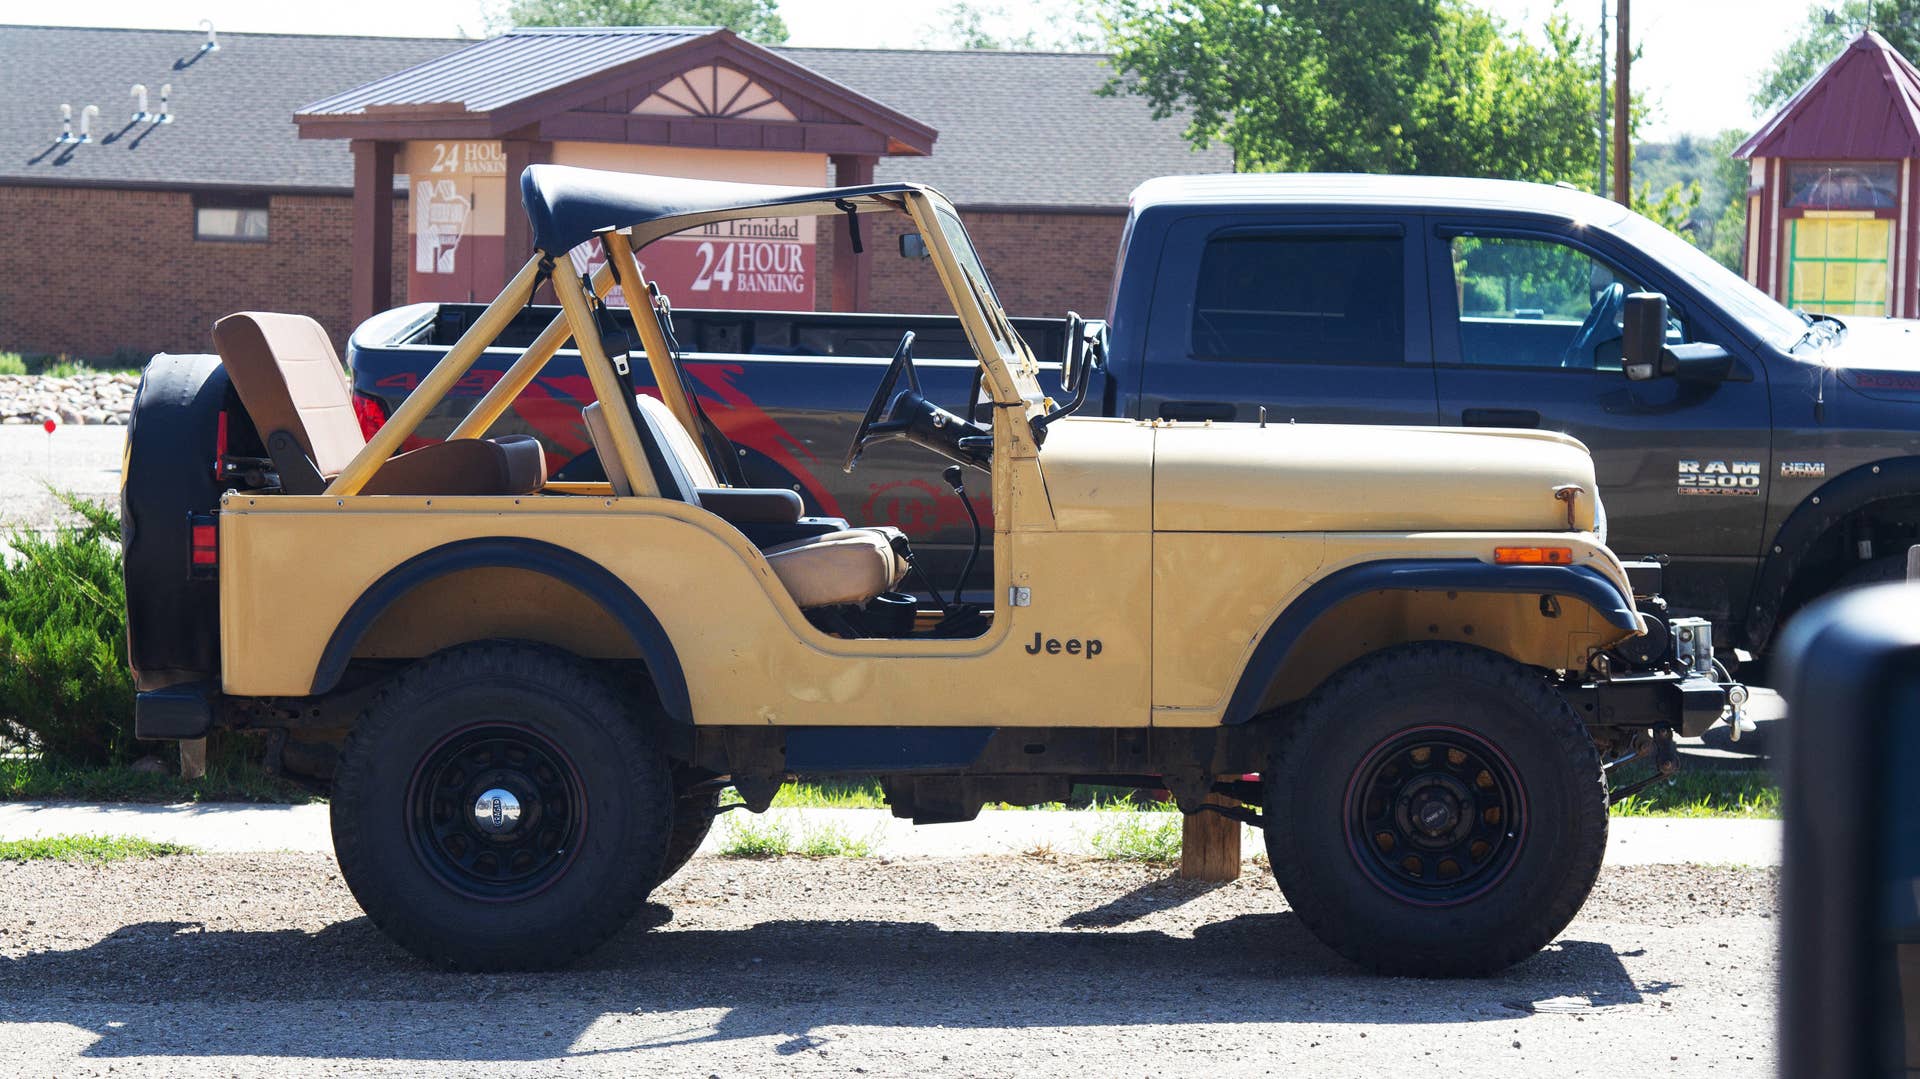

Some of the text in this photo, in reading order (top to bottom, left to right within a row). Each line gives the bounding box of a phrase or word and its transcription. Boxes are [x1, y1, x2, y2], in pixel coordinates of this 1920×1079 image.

[431, 143, 507, 173] 24 HOU
[464, 160, 507, 173] BANKIN
[728, 217, 799, 238] Trinidad
[690, 241, 806, 292] 24 HOUR
[737, 272, 807, 294] BANKING
[1678, 460, 1761, 474] RAM
[1781, 461, 1825, 472] HEMI
[1678, 474, 1760, 487] 2500
[1024, 631, 1103, 660] Jeep
